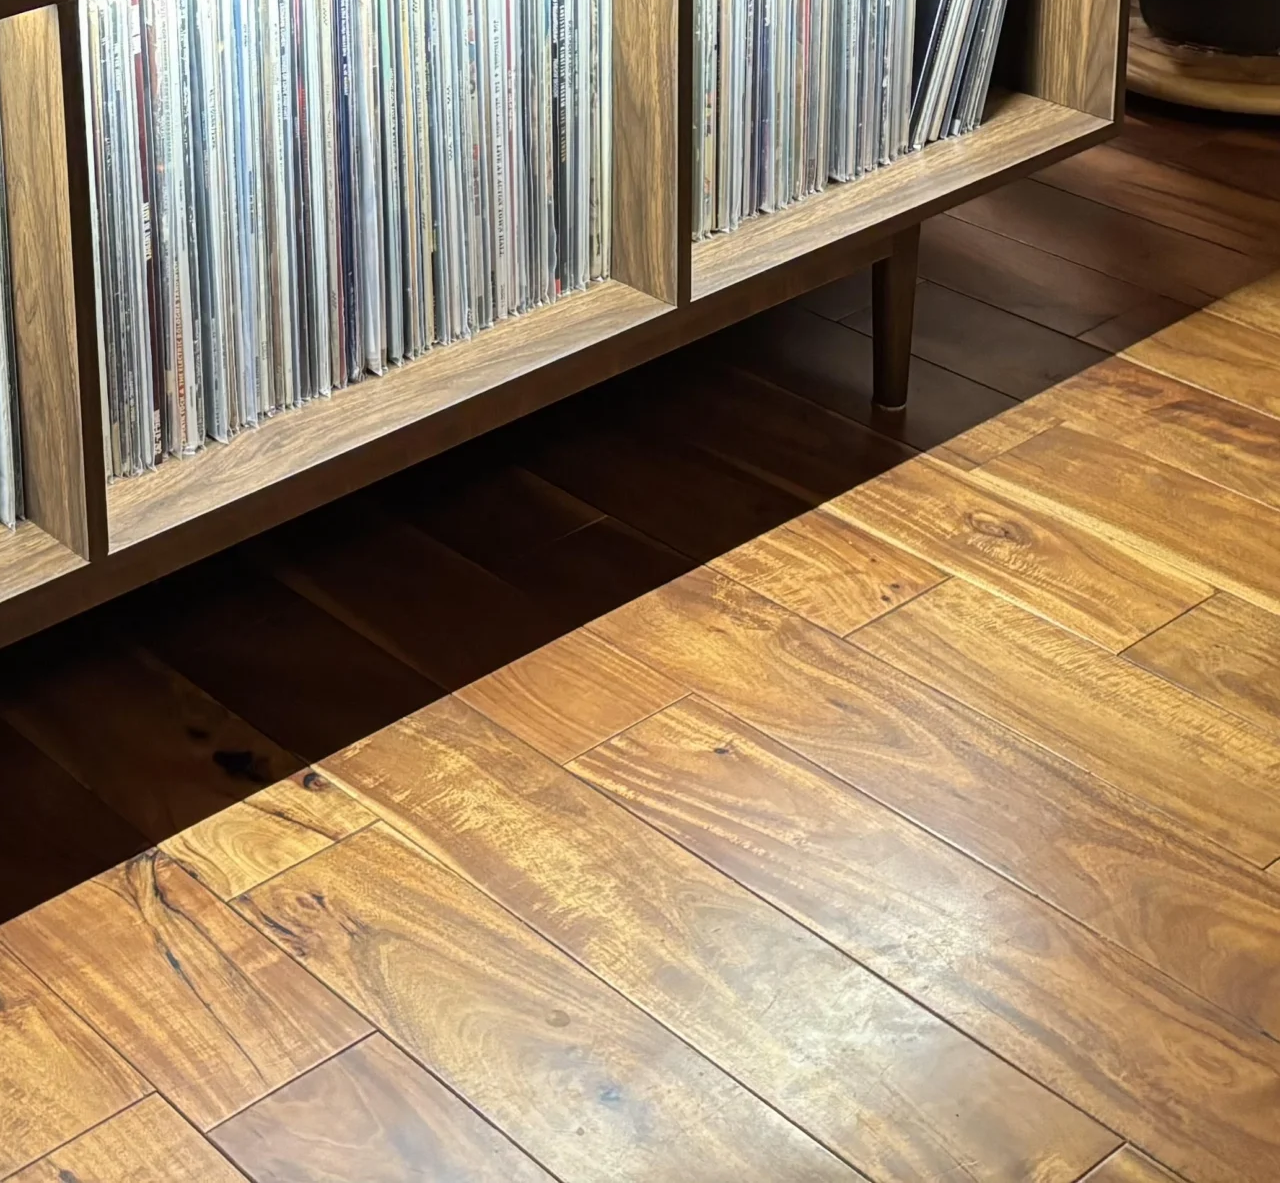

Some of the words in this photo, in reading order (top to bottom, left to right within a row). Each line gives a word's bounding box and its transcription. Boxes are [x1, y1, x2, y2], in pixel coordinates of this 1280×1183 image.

[560, 126, 565, 134] IN
[496, 165, 501, 175] AT
[173, 302, 182, 337] BOLOGNA
[175, 339, 183, 372] ELECTRIC
